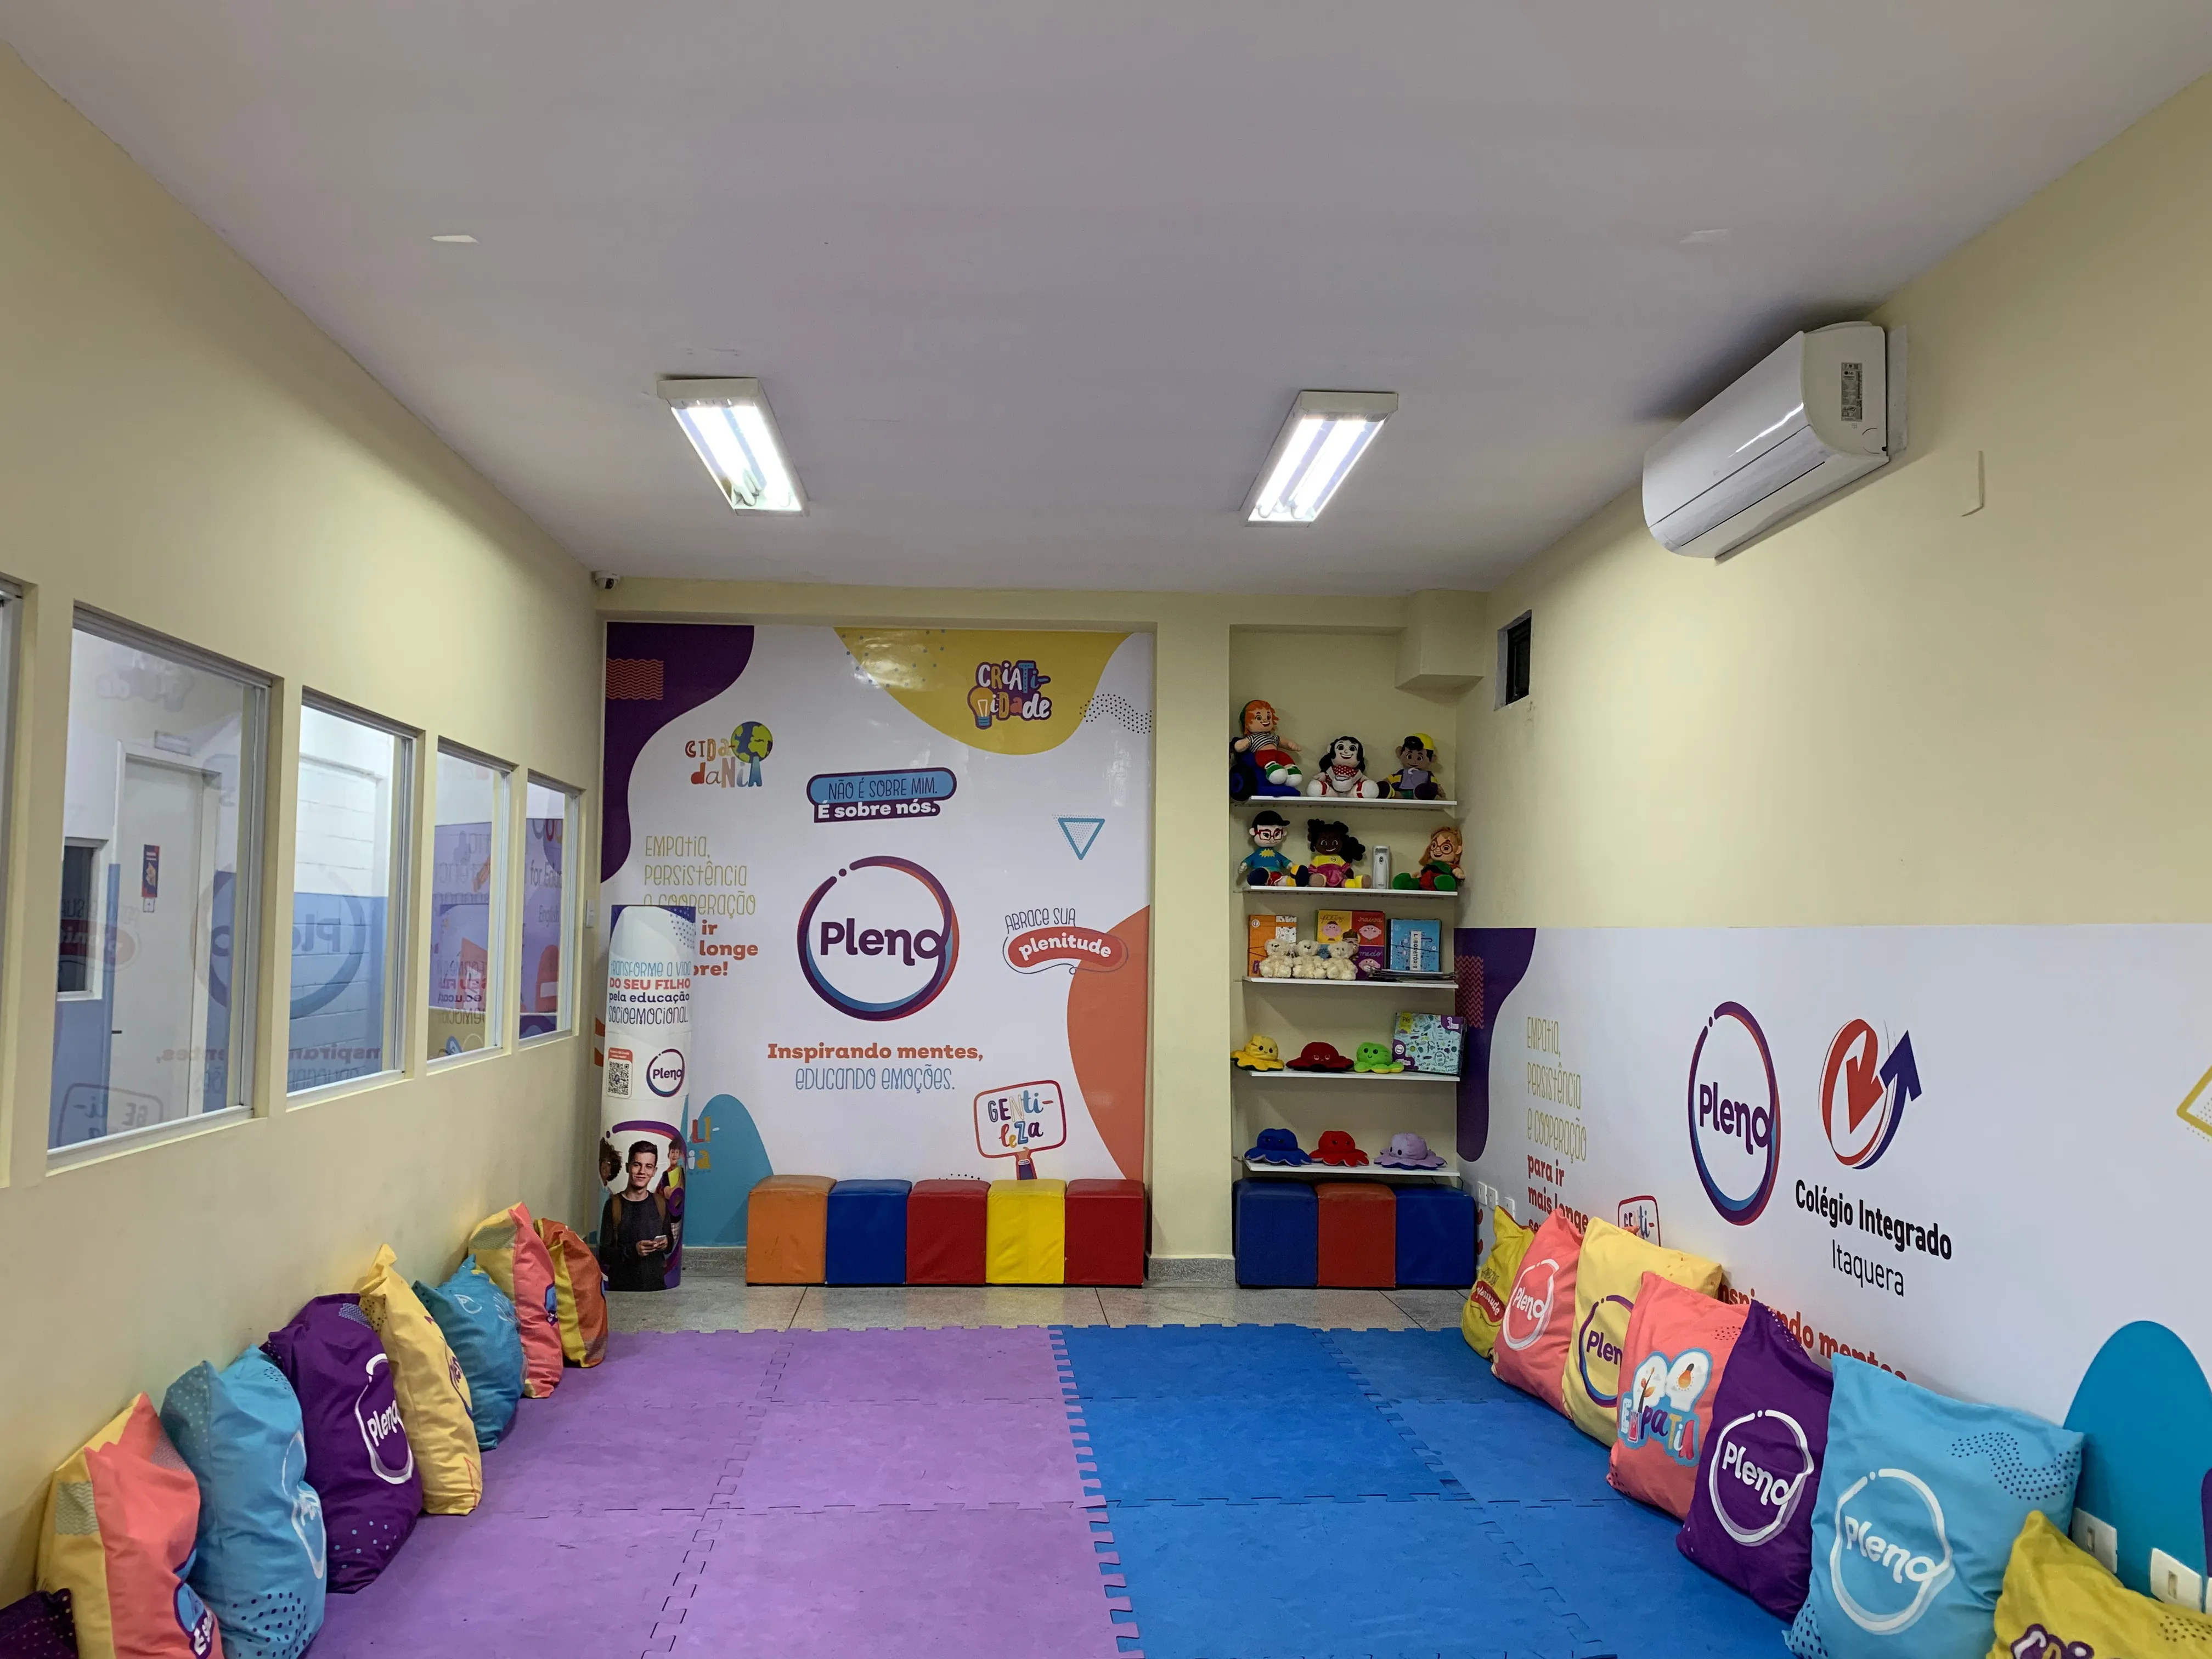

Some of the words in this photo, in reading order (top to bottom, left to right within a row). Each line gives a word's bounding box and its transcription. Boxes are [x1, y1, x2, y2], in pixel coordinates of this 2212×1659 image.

[828, 779, 854, 800] NÃO
[859, 777, 865, 798] É
[869, 778, 907, 798] SOBRE
[911, 777, 938, 795] MIM.
[818, 800, 830, 819] É
[834, 802, 891, 817] sobre
[895, 798, 936, 815] nós.
[701, 919, 718, 935] ir
[1053, 907, 1076, 927] SUA
[699, 940, 759, 961] longe
[820, 918, 946, 966] Pleno
[1018, 932, 1111, 961] plenitude
[608, 990, 627, 1003] pela
[629, 991, 690, 1004] educação
[609, 977, 622, 989] DO
[623, 979, 651, 990] SEU
[654, 978, 691, 990] FILHO
[767, 1042, 892, 1064] Inspirando
[896, 1043, 984, 1062] mentes,
[652, 1068, 683, 1080] Pleno
[1700, 1081, 1772, 1155] Pleno
[1527, 1154, 1553, 1183] para
[1555, 1159, 1565, 1187] ir
[1527, 1186, 1553, 1215] mais
[1795, 1179, 1853, 1228] Colégio
[1859, 1199, 1952, 1260] Integrado
[1832, 1239, 1904, 1297] Itaquera
[1512, 1286, 1545, 1321] Pleno
[1586, 1329, 1623, 1369] Plen
[366, 1400, 398, 1447] Pleno
[1722, 1441, 1791, 1506] Pleno
[1844, 1515, 1937, 1584] Pleno
